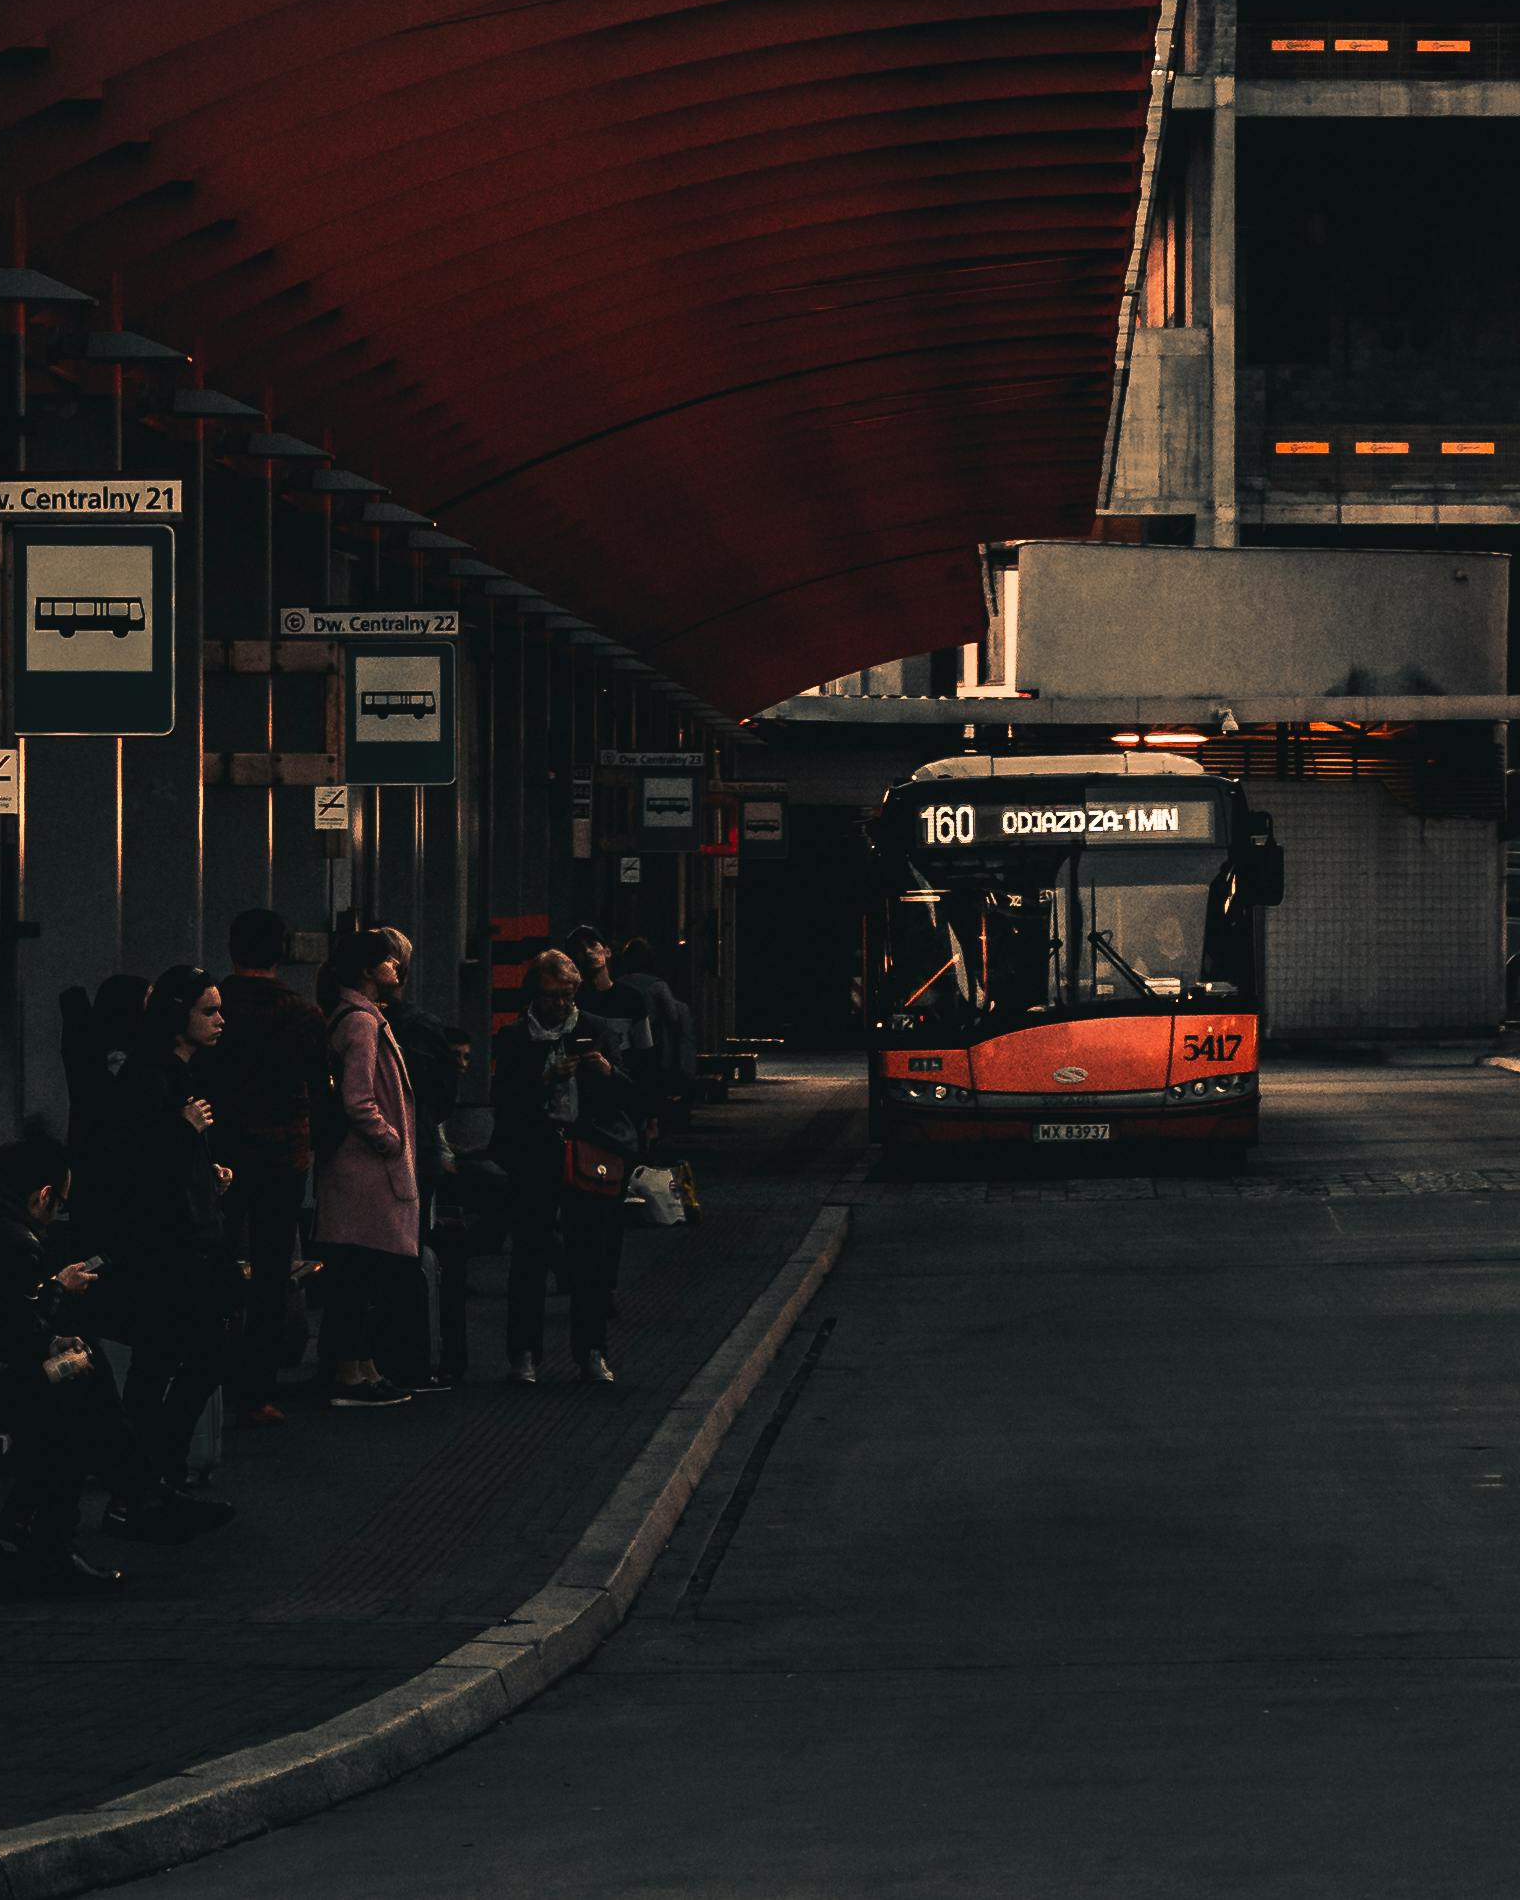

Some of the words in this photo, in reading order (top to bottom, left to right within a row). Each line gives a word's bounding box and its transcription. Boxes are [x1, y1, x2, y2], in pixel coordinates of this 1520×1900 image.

[21, 486, 140, 513] Centralny
[146, 487, 174, 510] 21
[314, 616, 346, 632] Dw.
[349, 615, 431, 635] Centralny
[434, 615, 456, 632] 22
[640, 753, 687, 766] Centralny
[689, 755, 702, 765] 23
[920, 804, 976, 844] 160
[1002, 810, 1086, 834] ODJAZD
[1137, 808, 1179, 832] MIN
[1183, 1034, 1242, 1061] 5417
[1041, 1126, 1060, 1139] WX
[1066, 1125, 1108, 1139] 83937
